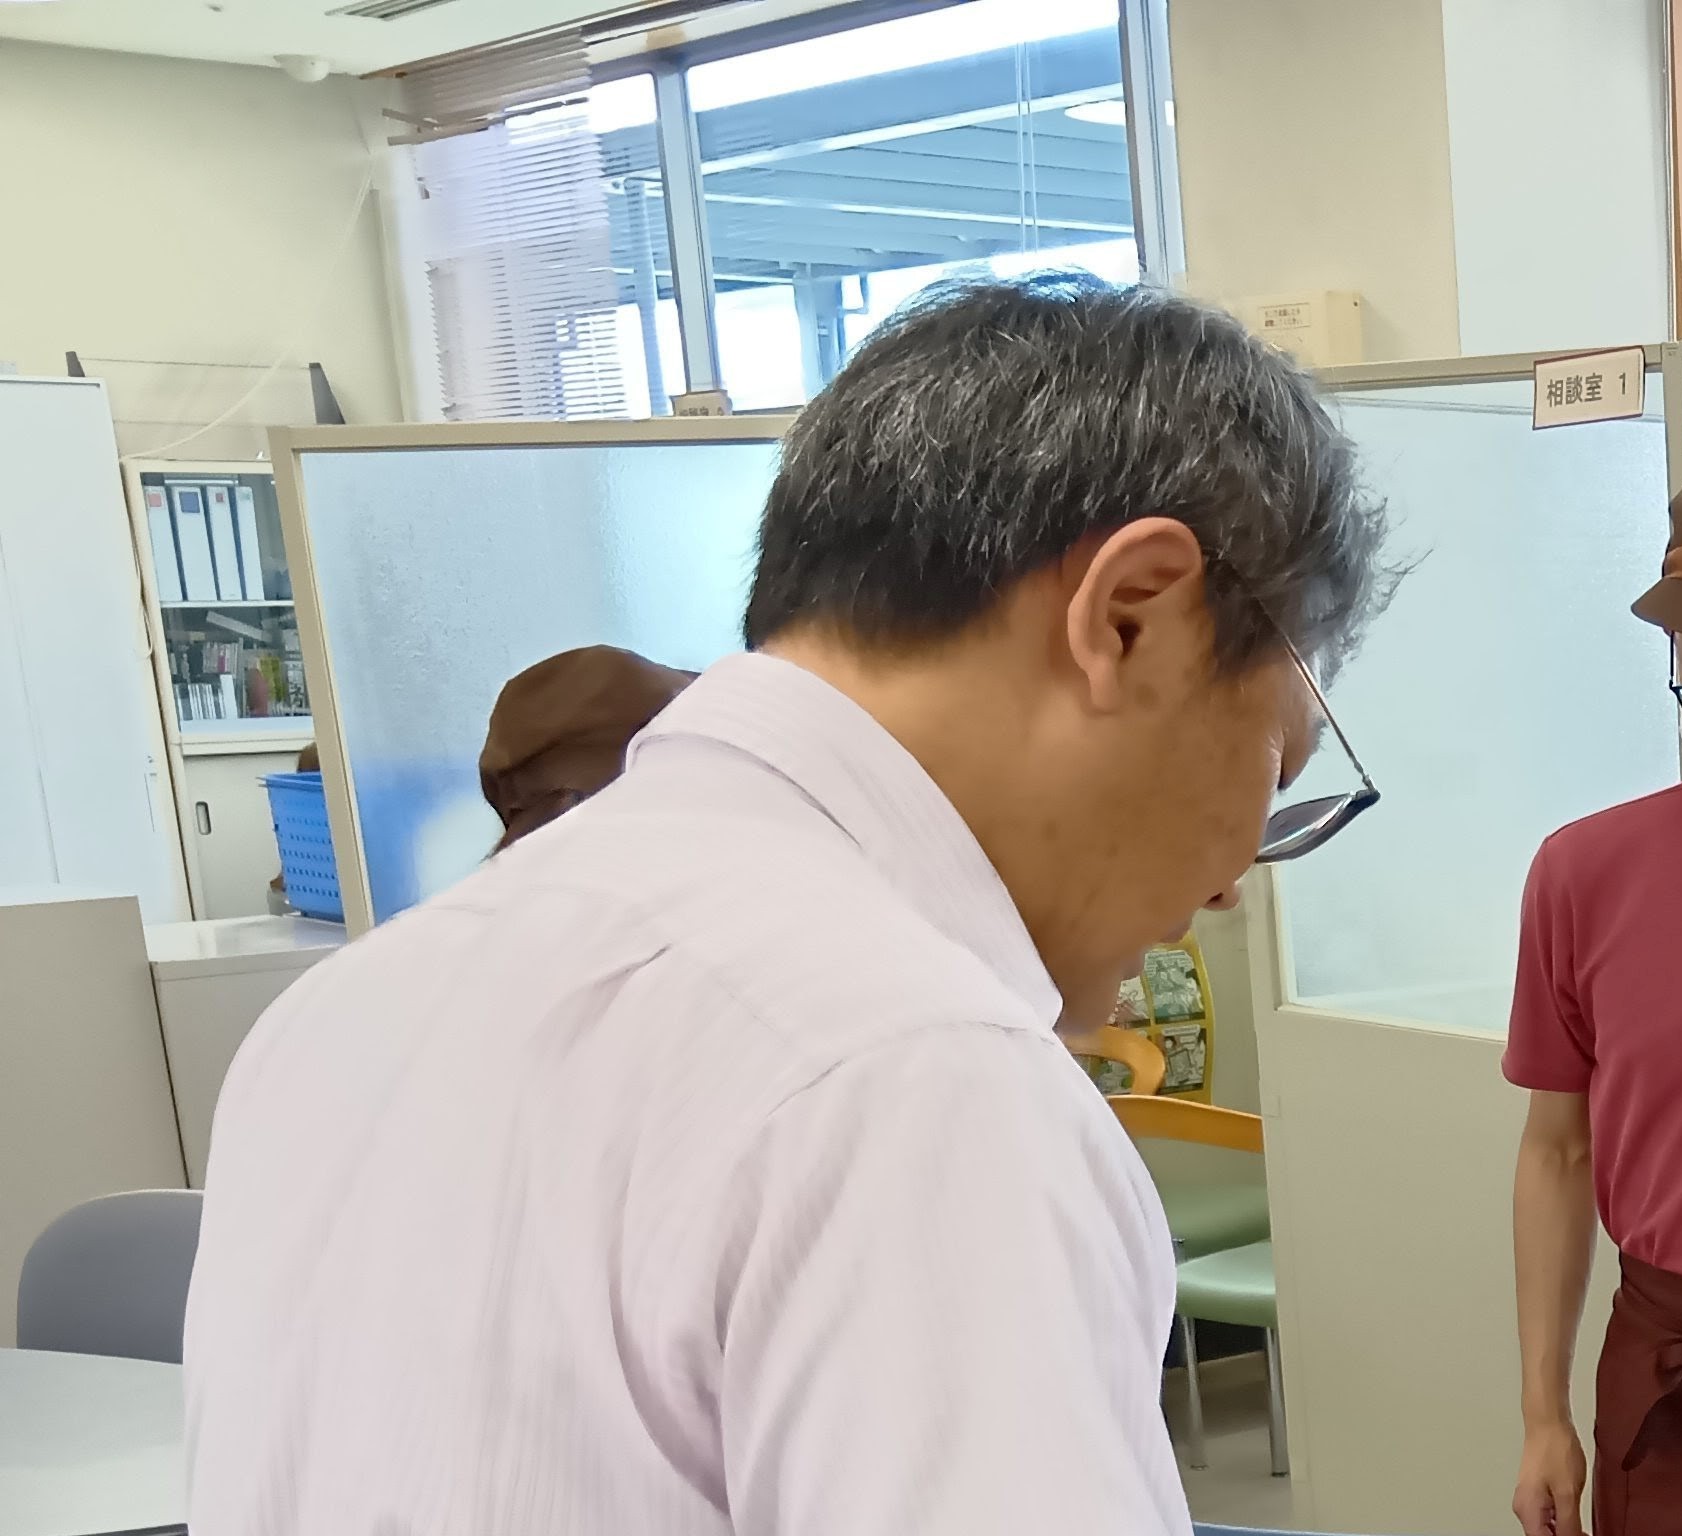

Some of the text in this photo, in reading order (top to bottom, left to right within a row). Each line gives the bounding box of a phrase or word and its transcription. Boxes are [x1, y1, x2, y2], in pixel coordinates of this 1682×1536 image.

[1547, 372, 1626, 407] 相談室 1
